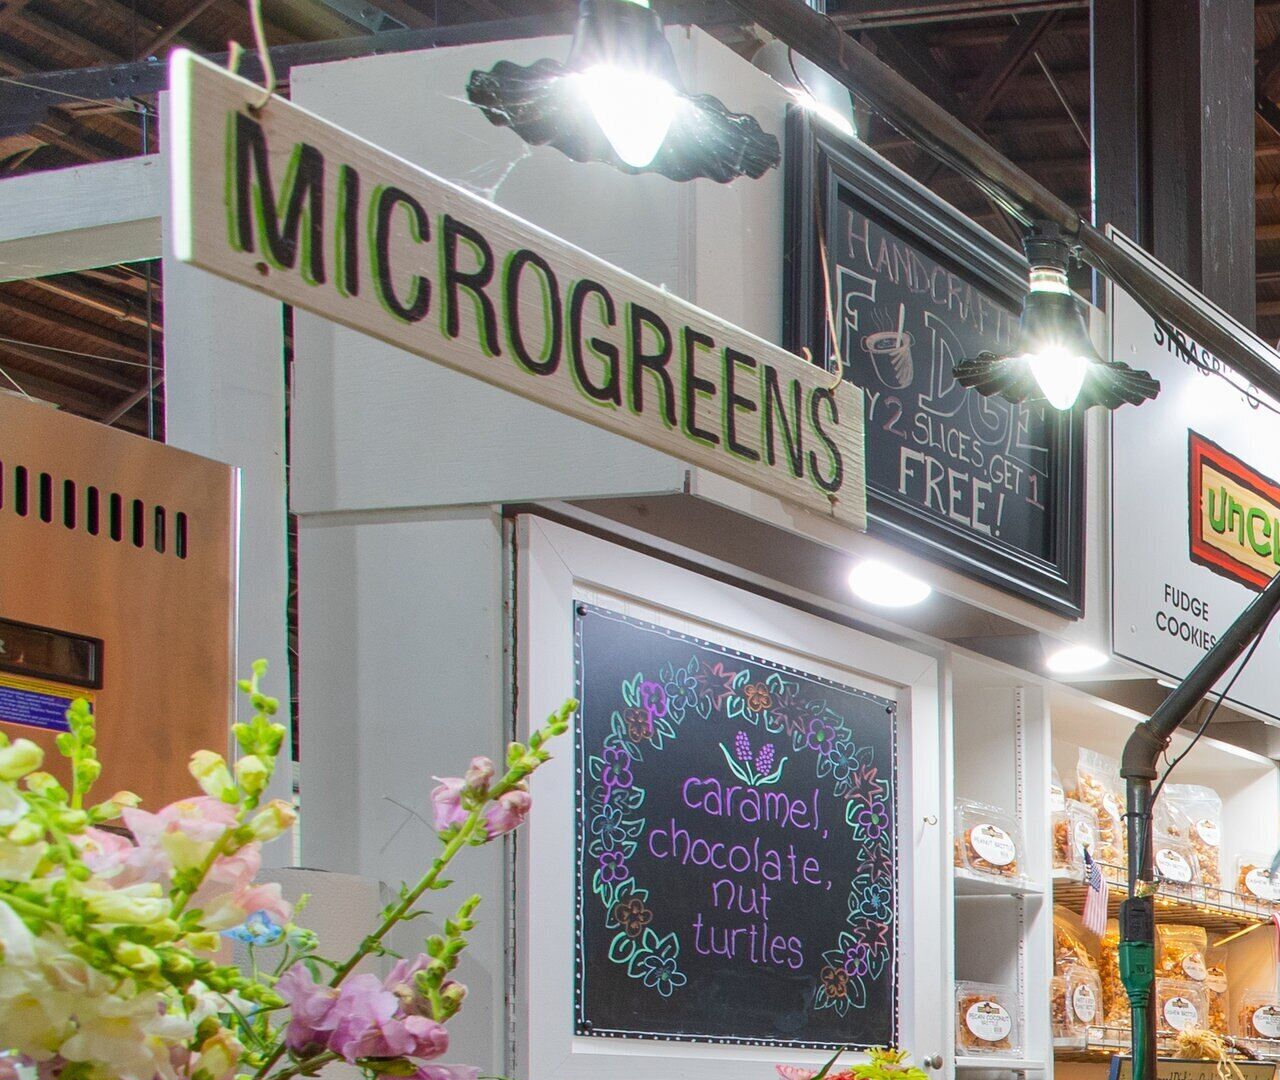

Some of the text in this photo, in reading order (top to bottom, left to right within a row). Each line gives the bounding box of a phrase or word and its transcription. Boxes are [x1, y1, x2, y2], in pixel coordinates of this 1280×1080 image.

[224, 109, 845, 496] MICROGREENS
[898, 446, 1006, 537] FREE!
[989, 454, 1024, 495] GET
[1164, 584, 1209, 622] FUDGE
[1156, 611, 1217, 652] COOKIES
[683, 776, 829, 839] caramel,
[650, 818, 832, 891] chocolate,
[712, 879, 771, 920] nut
[693, 913, 804, 969] turtles
